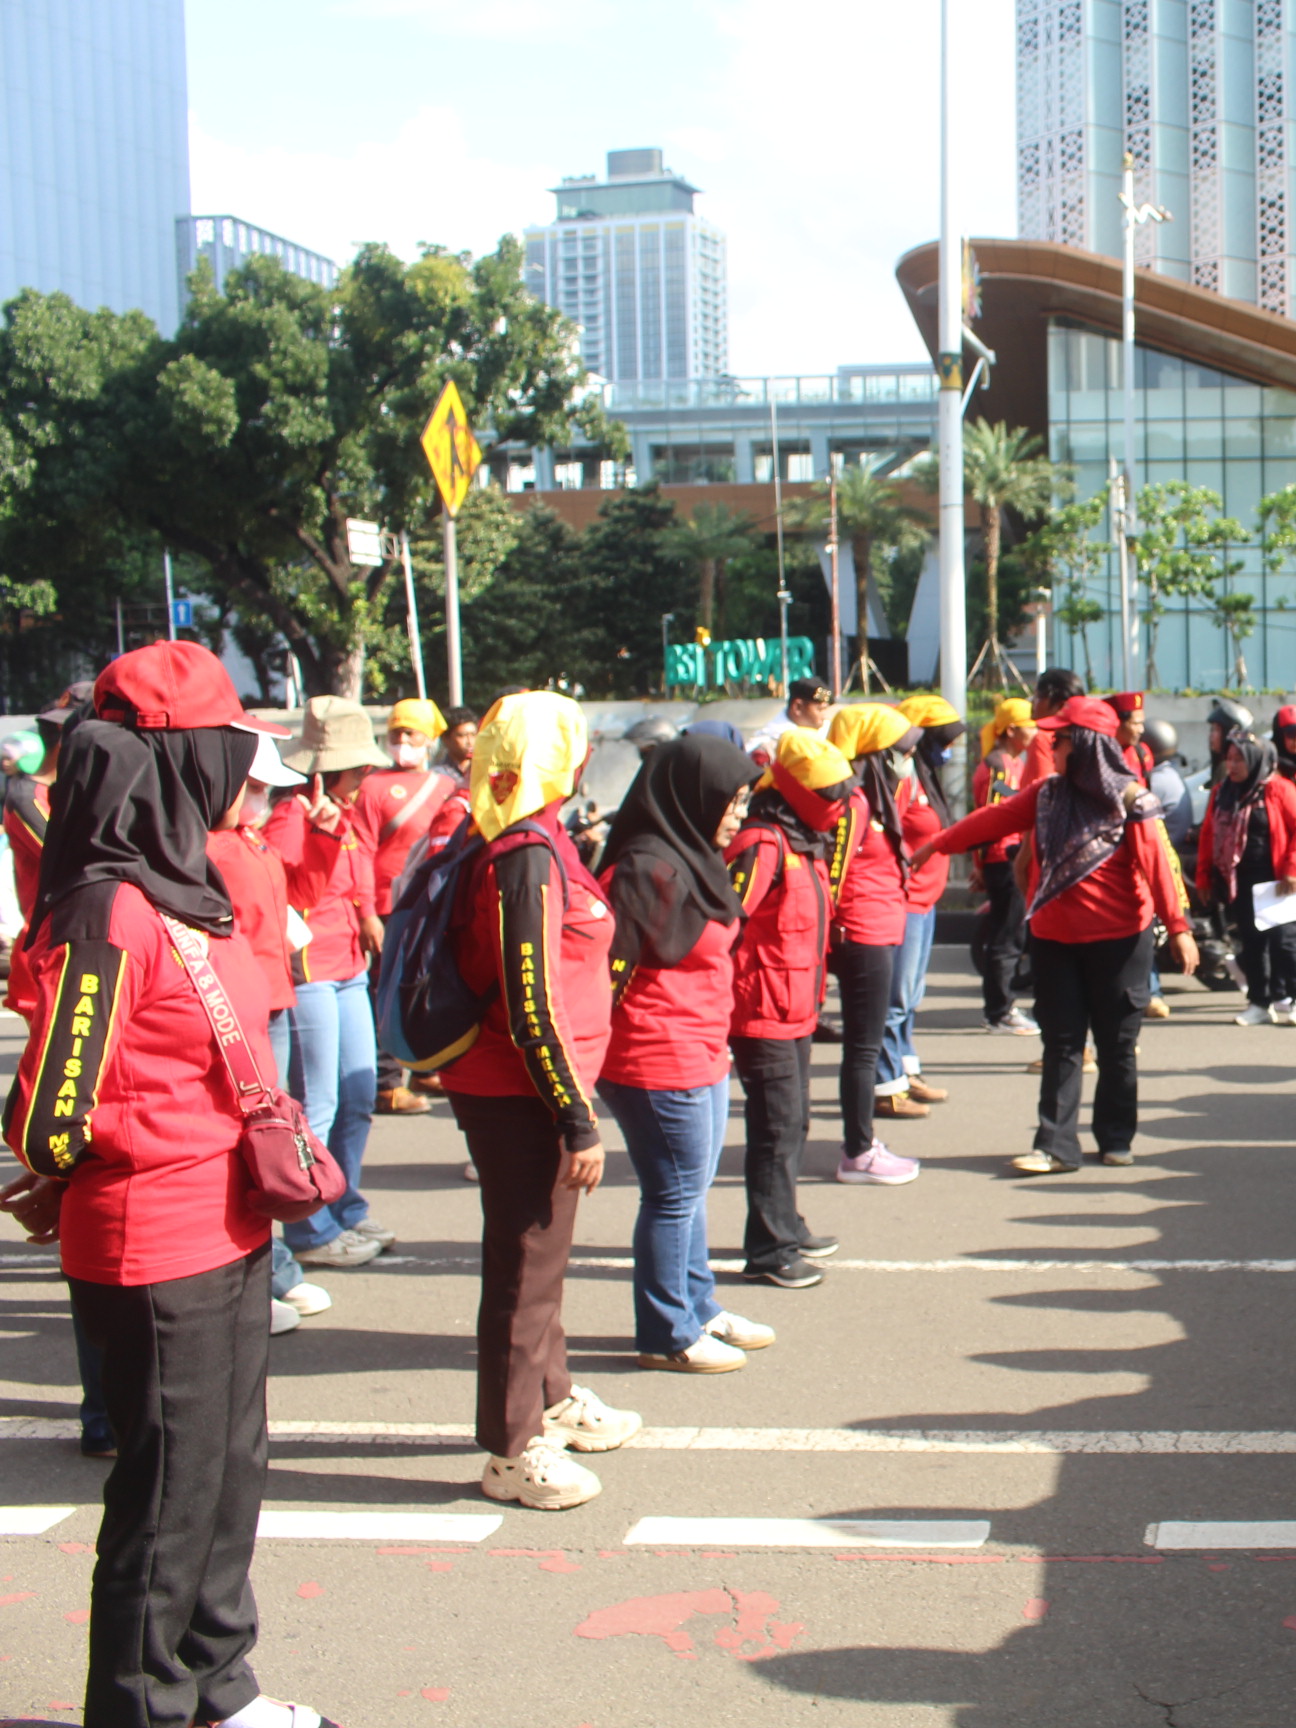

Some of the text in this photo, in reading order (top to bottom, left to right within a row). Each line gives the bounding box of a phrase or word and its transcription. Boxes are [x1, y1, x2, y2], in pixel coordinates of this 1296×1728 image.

[666, 636, 815, 686] BSI TOWER
[205, 987, 241, 1047] MODE
[521, 942, 542, 1038] BARISAN
[54, 973, 99, 1118] BARISAN
